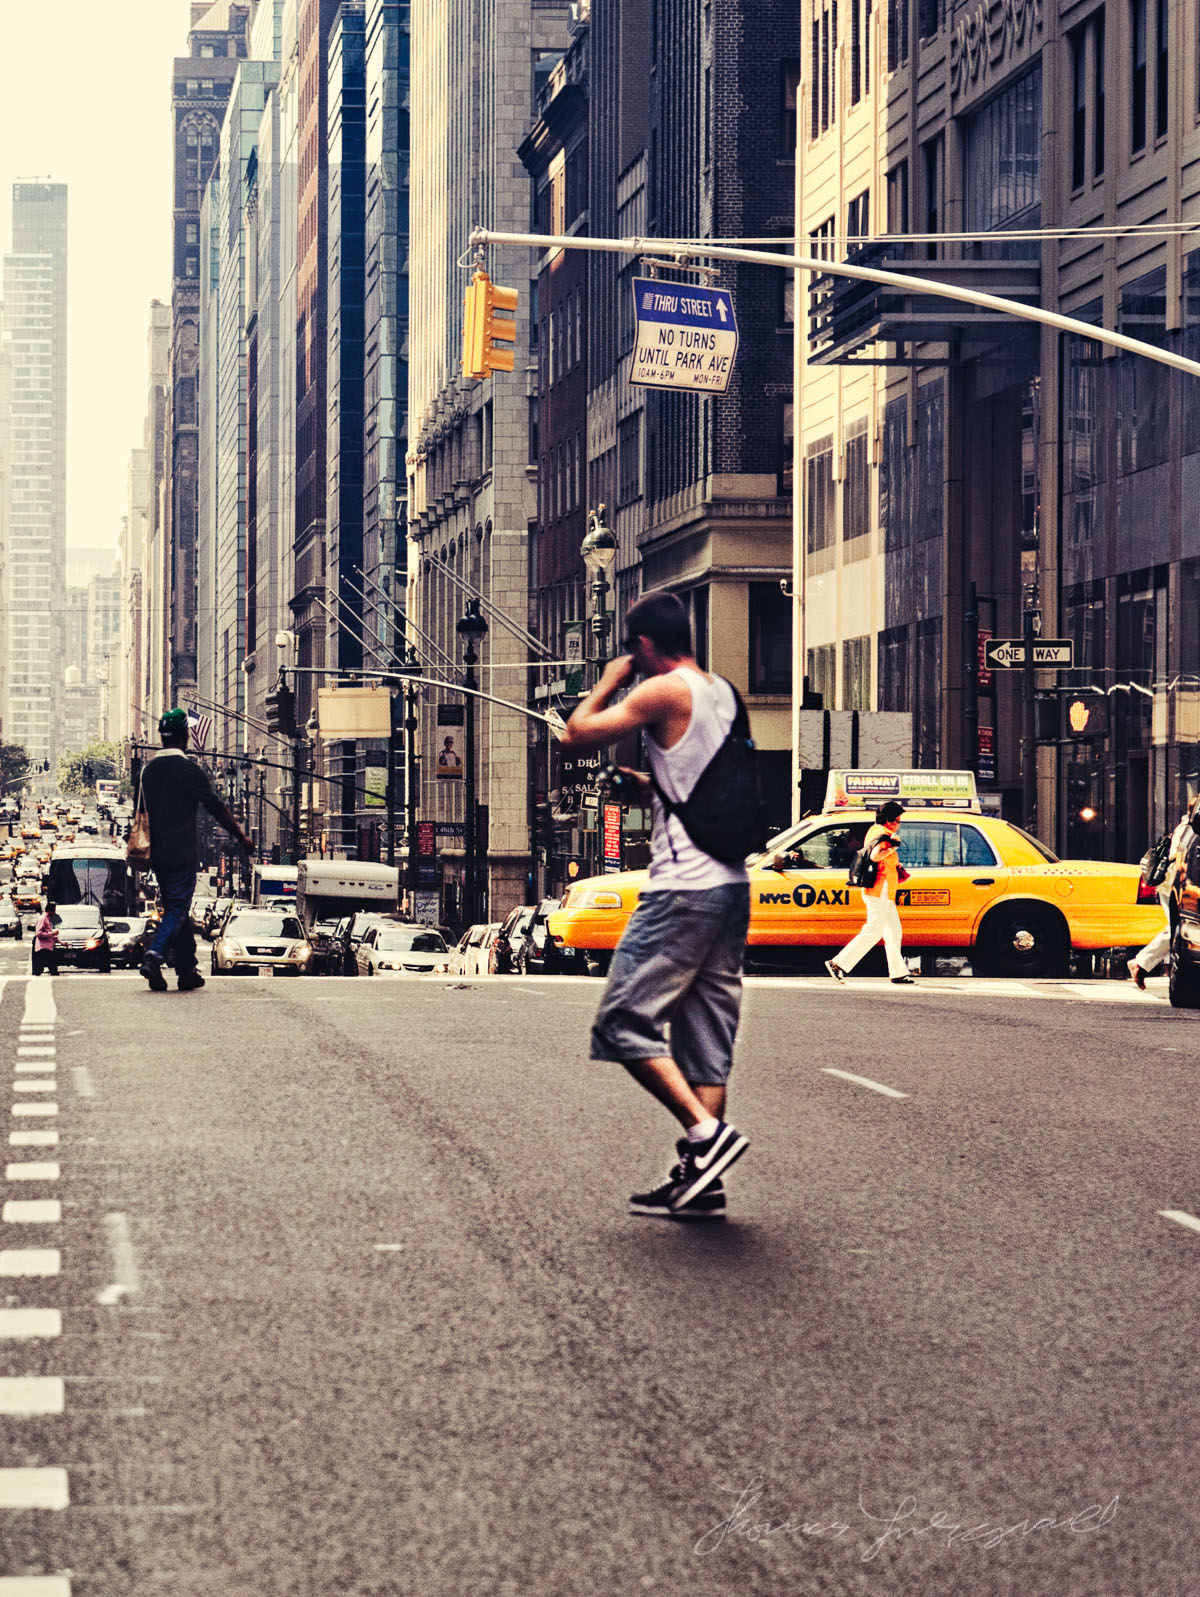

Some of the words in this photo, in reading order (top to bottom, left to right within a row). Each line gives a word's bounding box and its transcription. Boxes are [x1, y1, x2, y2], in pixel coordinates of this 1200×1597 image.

[654, 294, 678, 313] THRU
[680, 297, 712, 318] STREET
[659, 328, 675, 346] NO
[680, 331, 716, 351] TURNS
[639, 347, 669, 367] UNTIL
[675, 351, 705, 371] PARK
[708, 355, 730, 373] AVE
[637, 367, 675, 380] 10AM-6PM
[693, 373, 724, 386] MON-FRI
[997, 648, 1021, 661] ONE
[1035, 648, 1061, 661] WAY
[586, 772, 594, 781] &
[847, 776, 898, 787] FAIRWAY
[902, 774, 938, 786] STROLL
[940, 775, 955, 786] ON
[957, 776, 969, 786] IN
[575, 783, 600, 792] SALA
[760, 893, 791, 905] NYC
[793, 884, 850, 908] TAXI
